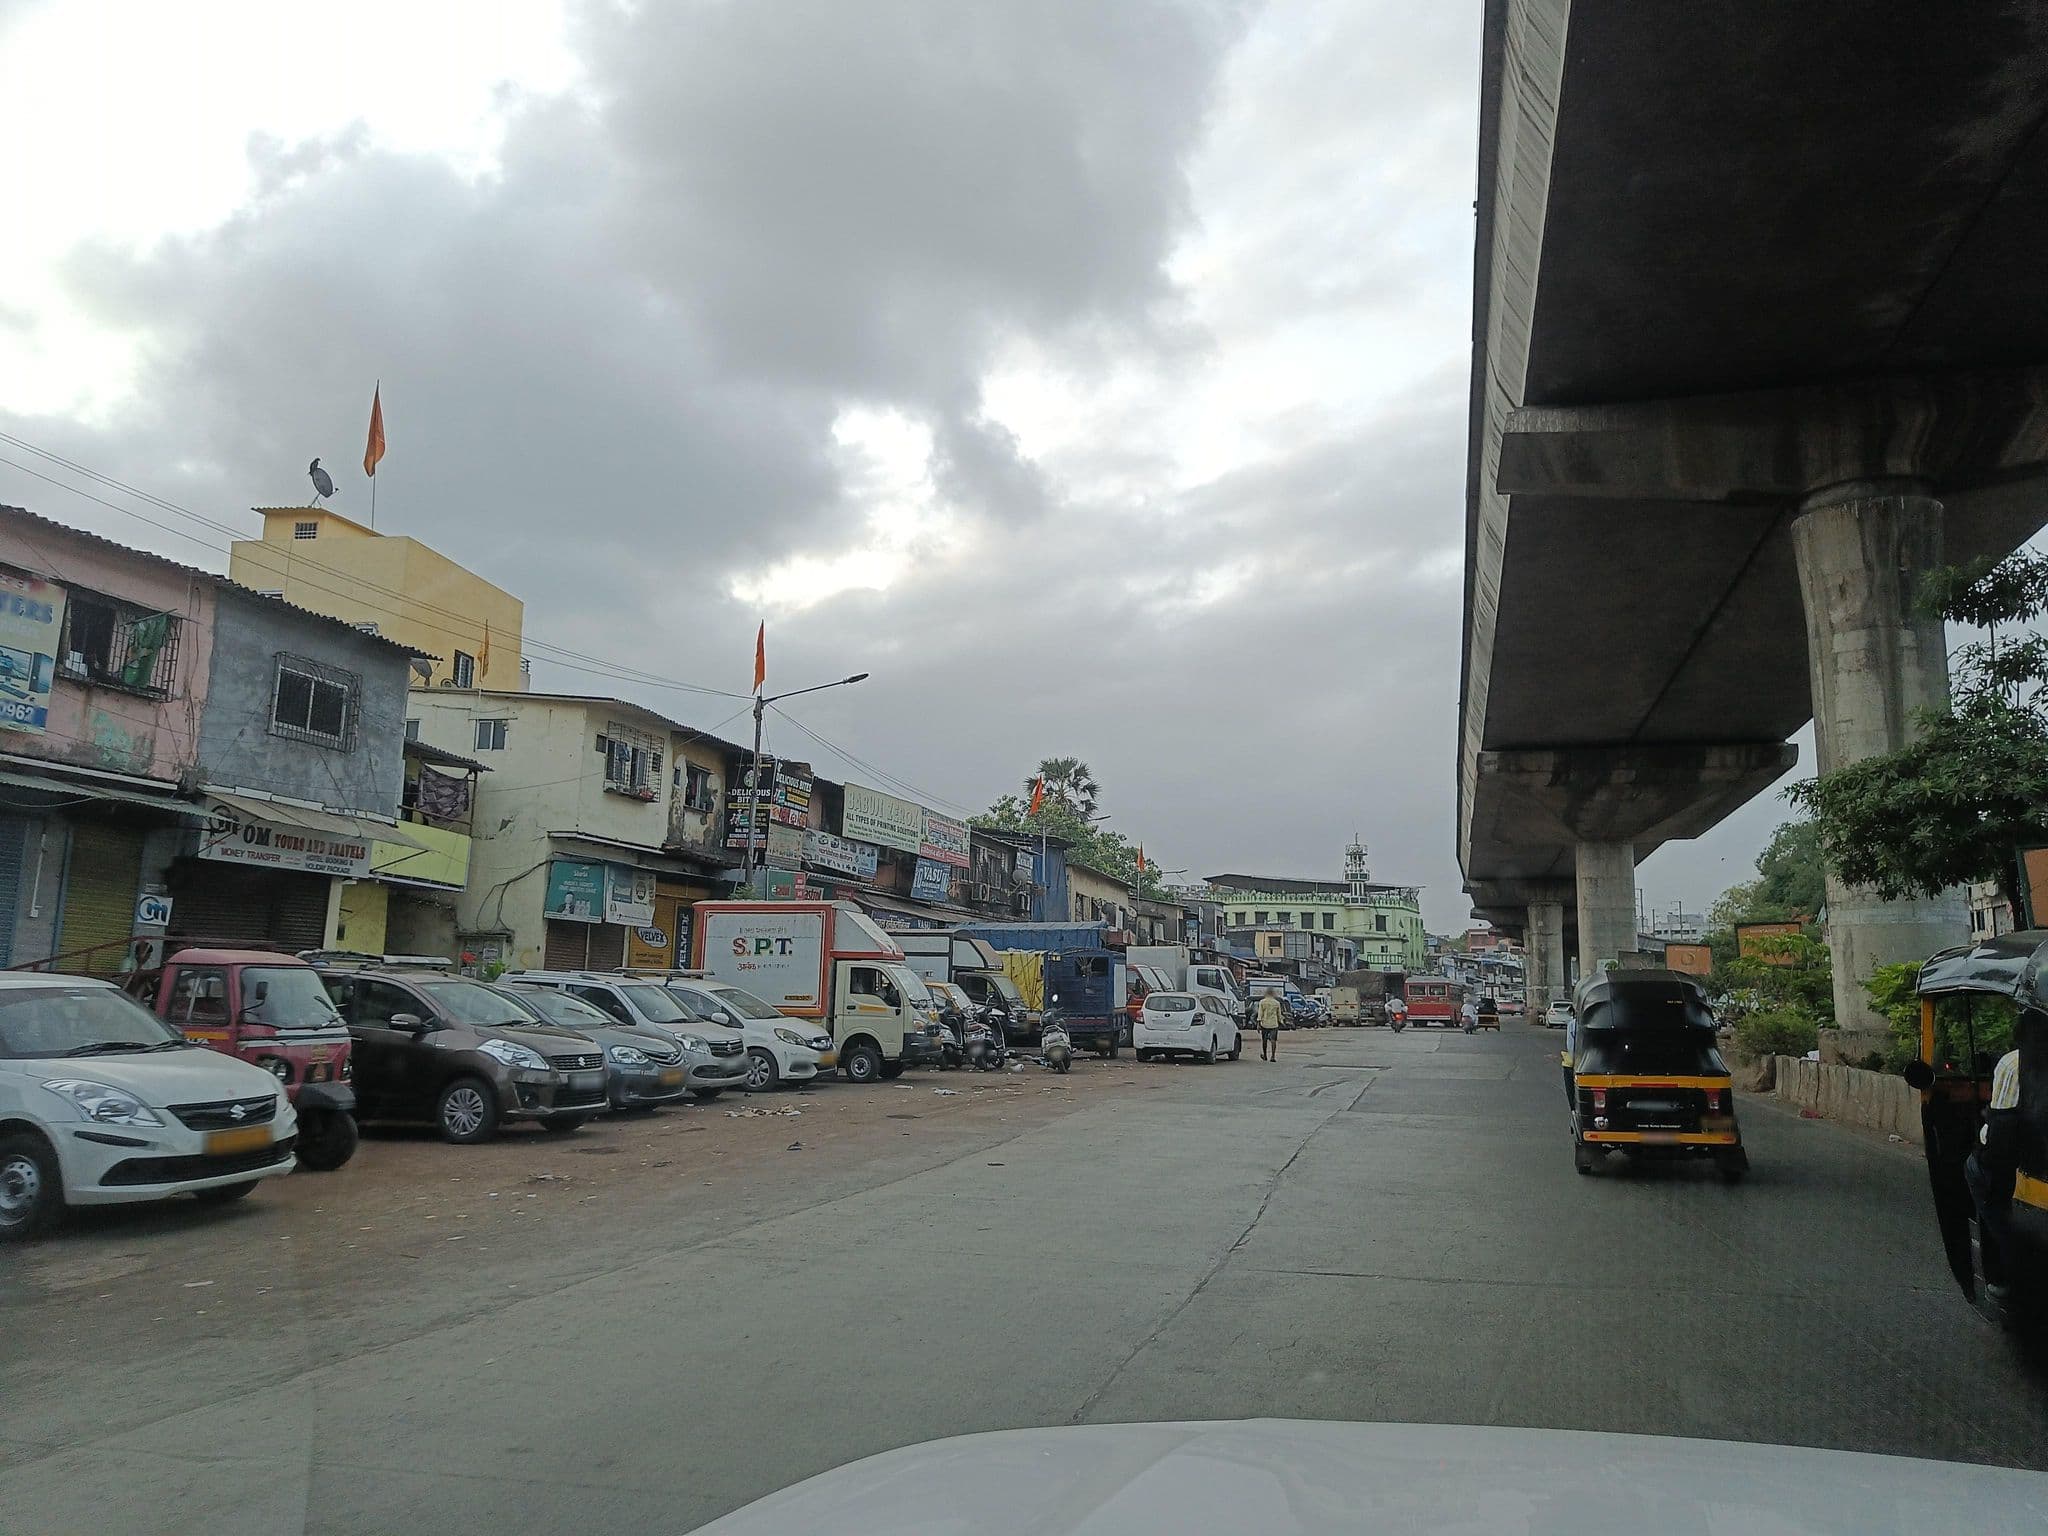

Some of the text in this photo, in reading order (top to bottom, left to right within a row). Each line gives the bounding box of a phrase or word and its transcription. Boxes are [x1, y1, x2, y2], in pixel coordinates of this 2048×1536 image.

[776, 772, 799, 788] DELICIOUS
[799, 780, 812, 792] BITES
[731, 788, 771, 797] DELICOUS
[847, 791, 883, 818] BABUJI
[846, 812, 855, 822] ALL
[855, 814, 870, 825] TYPES
[870, 817, 877, 826] OF
[876, 818, 897, 832] PRINTING
[242, 824, 272, 847] OM
[274, 834, 305, 852] TOURS
[306, 838, 327, 854] AND
[328, 841, 365, 860] TRAVELS
[220, 848, 244, 858] MONEY
[247, 851, 281, 863] TRANSFER
[325, 858, 348, 866] BOOKING
[305, 862, 326, 872] HOLIDAY
[640, 930, 665, 943] VELVEX
